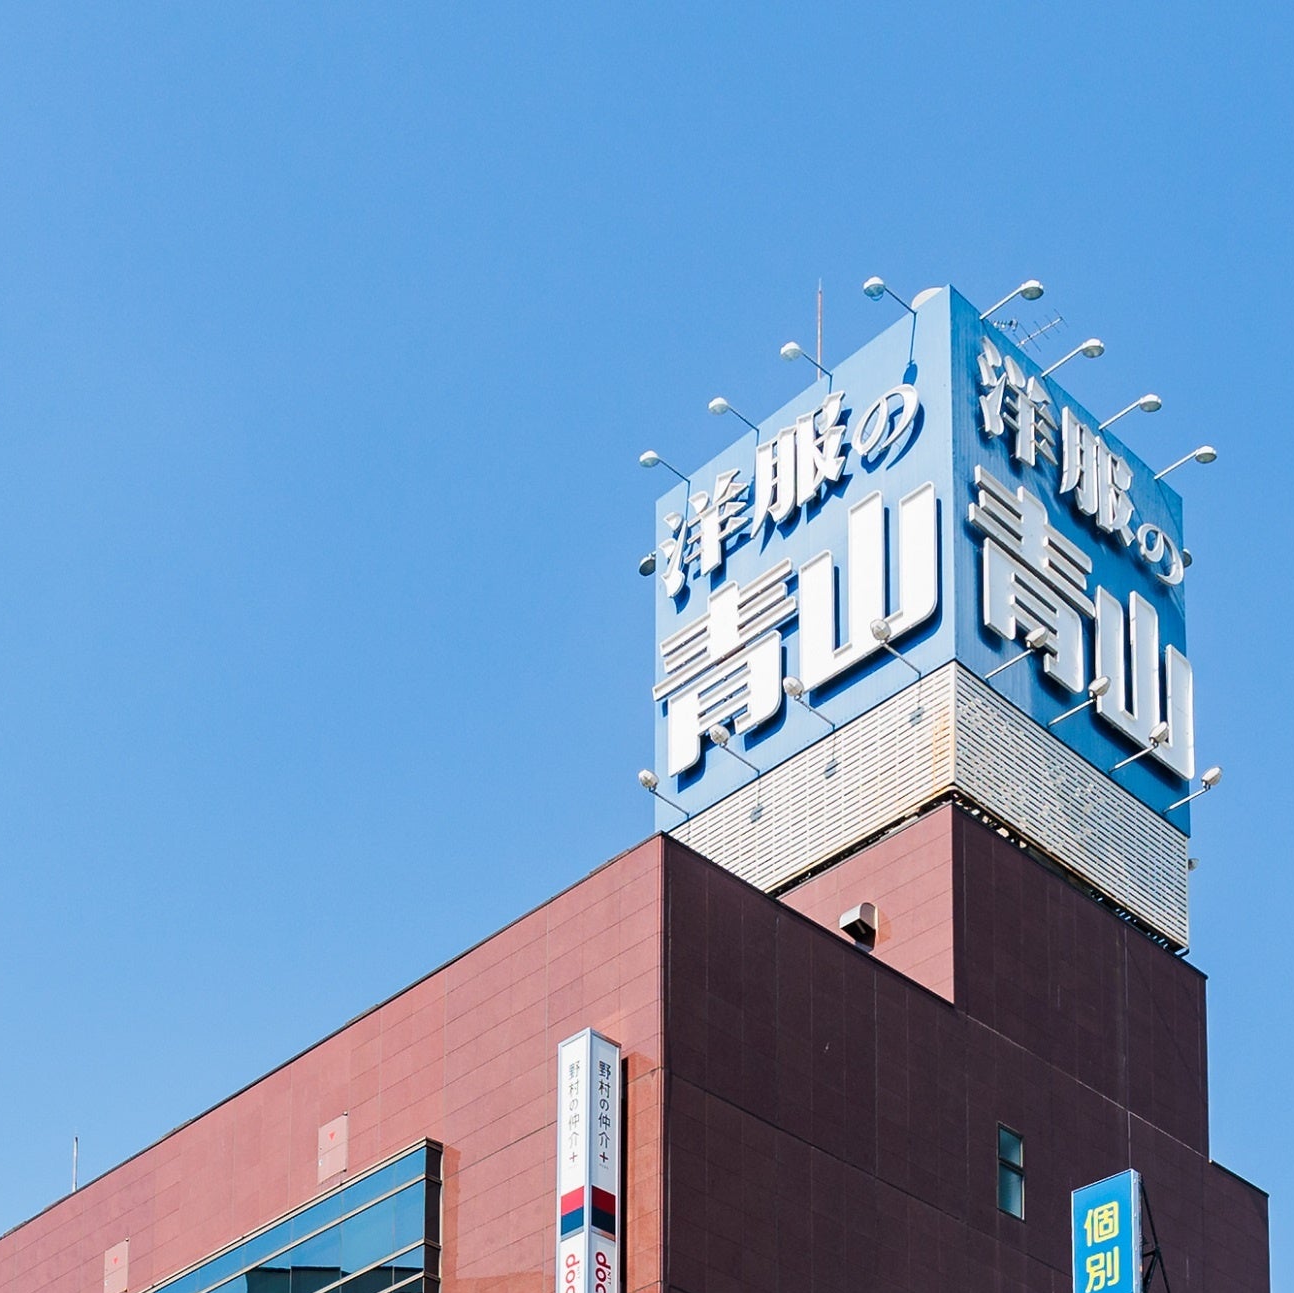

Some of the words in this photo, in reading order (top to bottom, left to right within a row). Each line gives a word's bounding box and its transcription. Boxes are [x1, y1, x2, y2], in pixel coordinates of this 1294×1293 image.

[660, 384, 919, 598] 洋服の
[978, 336, 1186, 586] 洋服の
[653, 481, 937, 777] 青山
[969, 465, 1195, 779] 青山
[1083, 1200, 1119, 1293] 個別
